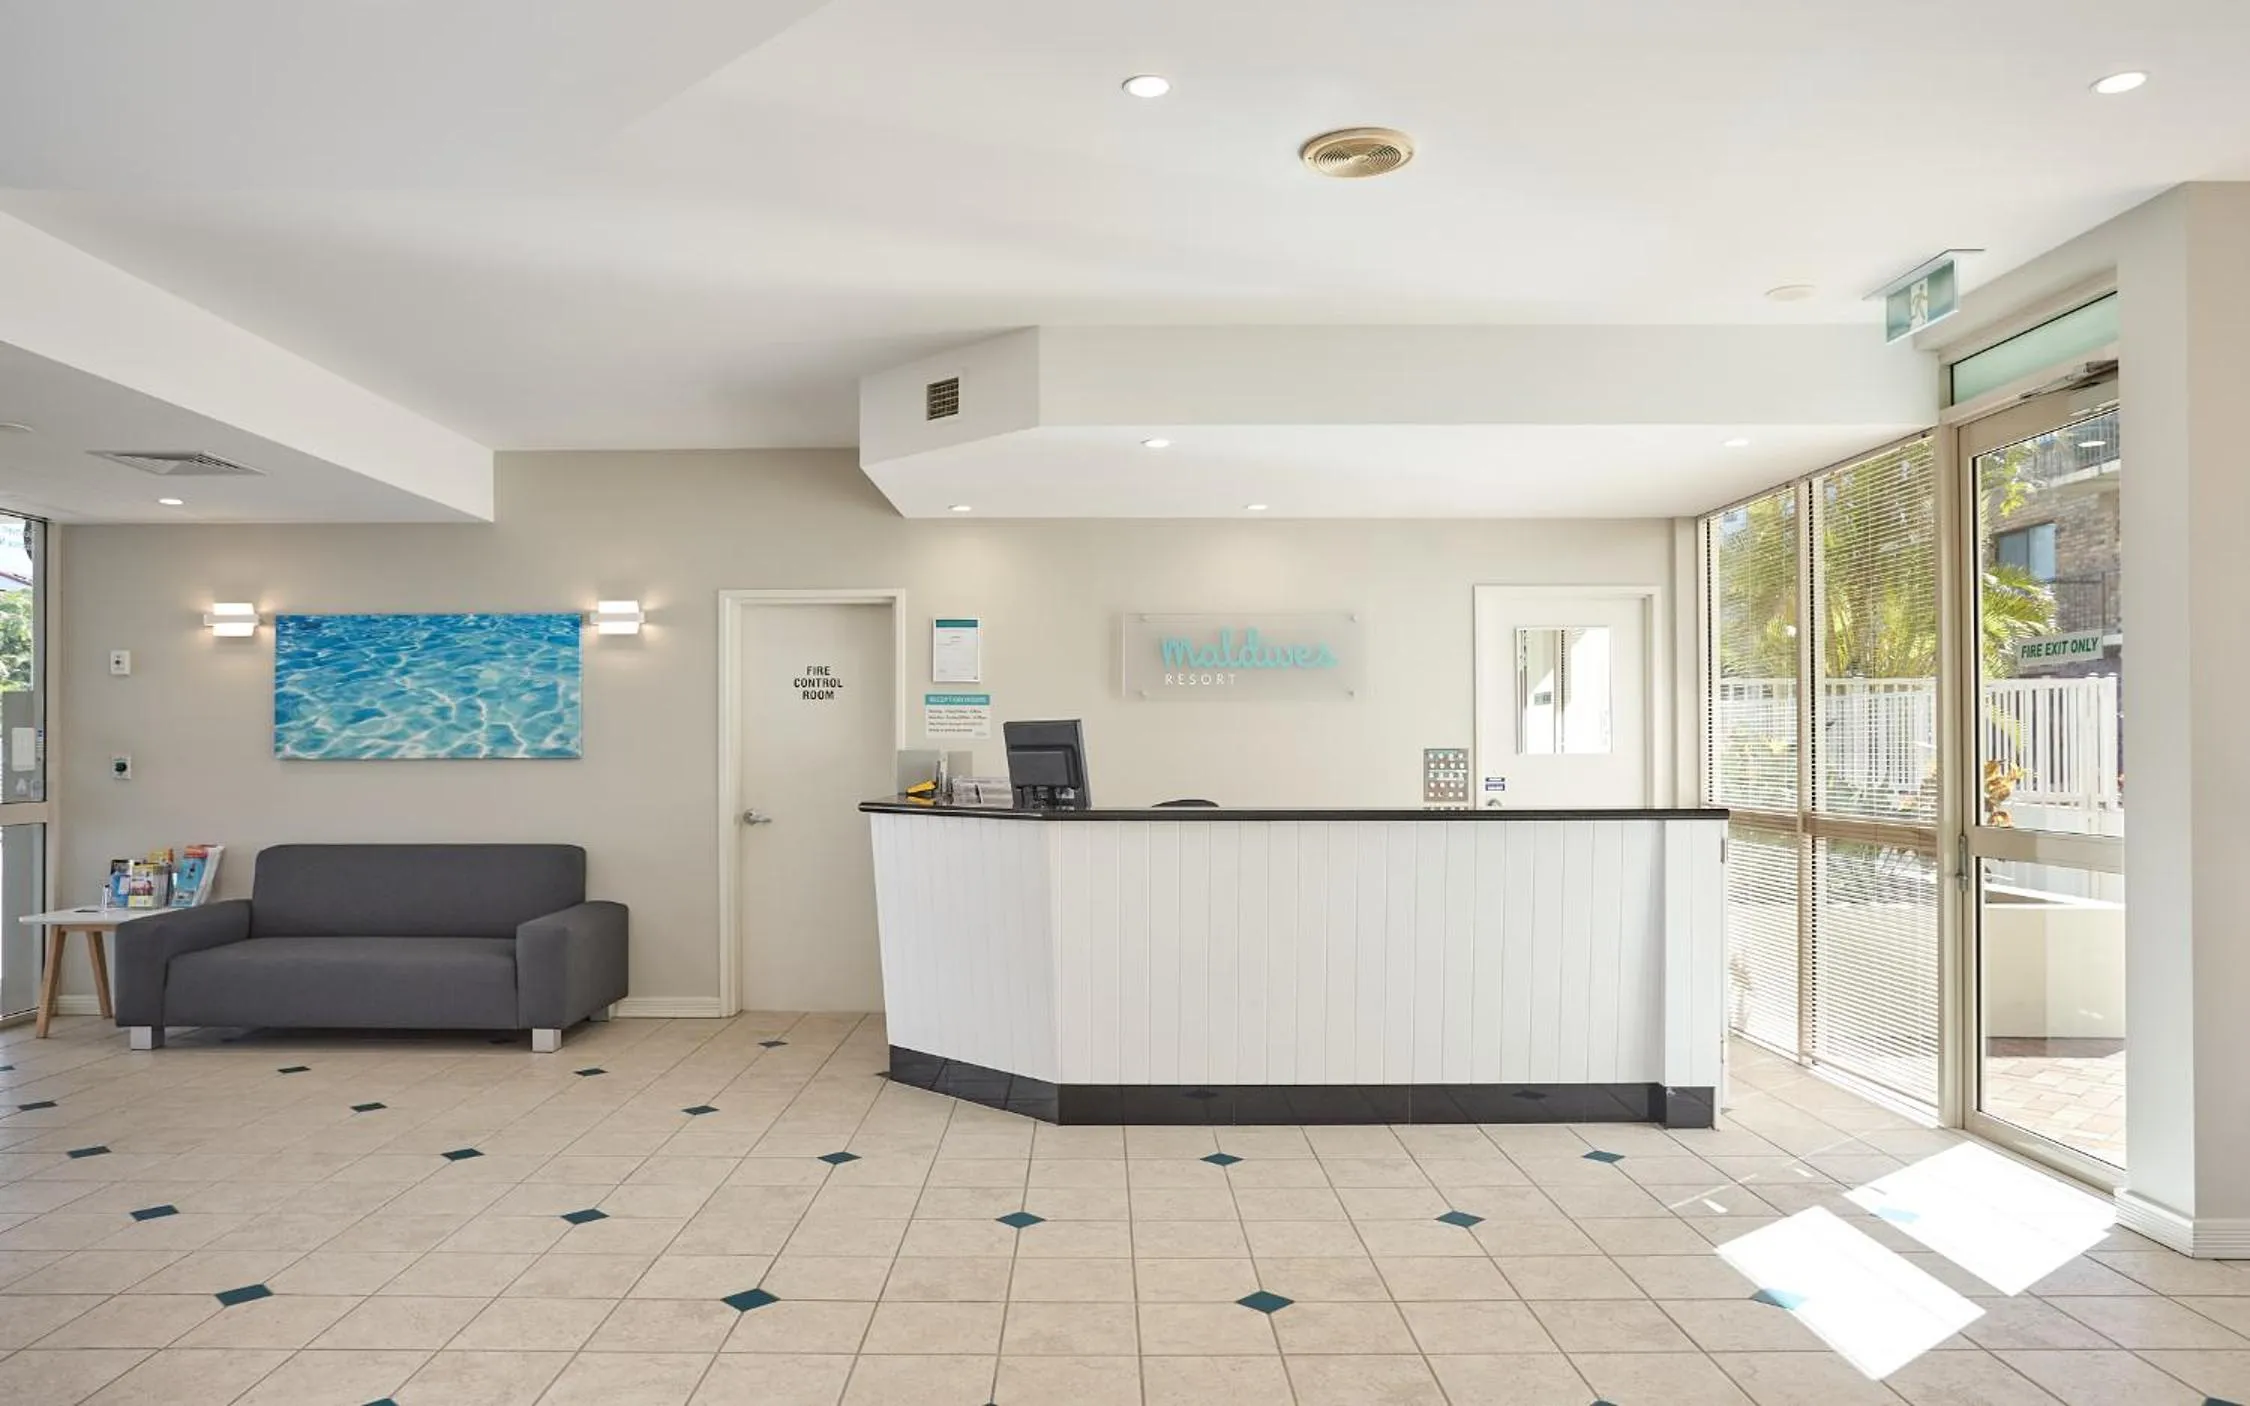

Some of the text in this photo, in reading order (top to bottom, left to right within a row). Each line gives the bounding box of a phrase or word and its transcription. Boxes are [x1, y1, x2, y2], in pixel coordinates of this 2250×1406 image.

[2021, 638, 2098, 658] FIRE EXIT ONLY
[806, 665, 831, 676] FIRE
[794, 677, 844, 688] CONTROL
[1164, 673, 1236, 685] RESORT
[802, 690, 834, 700] ROOM
